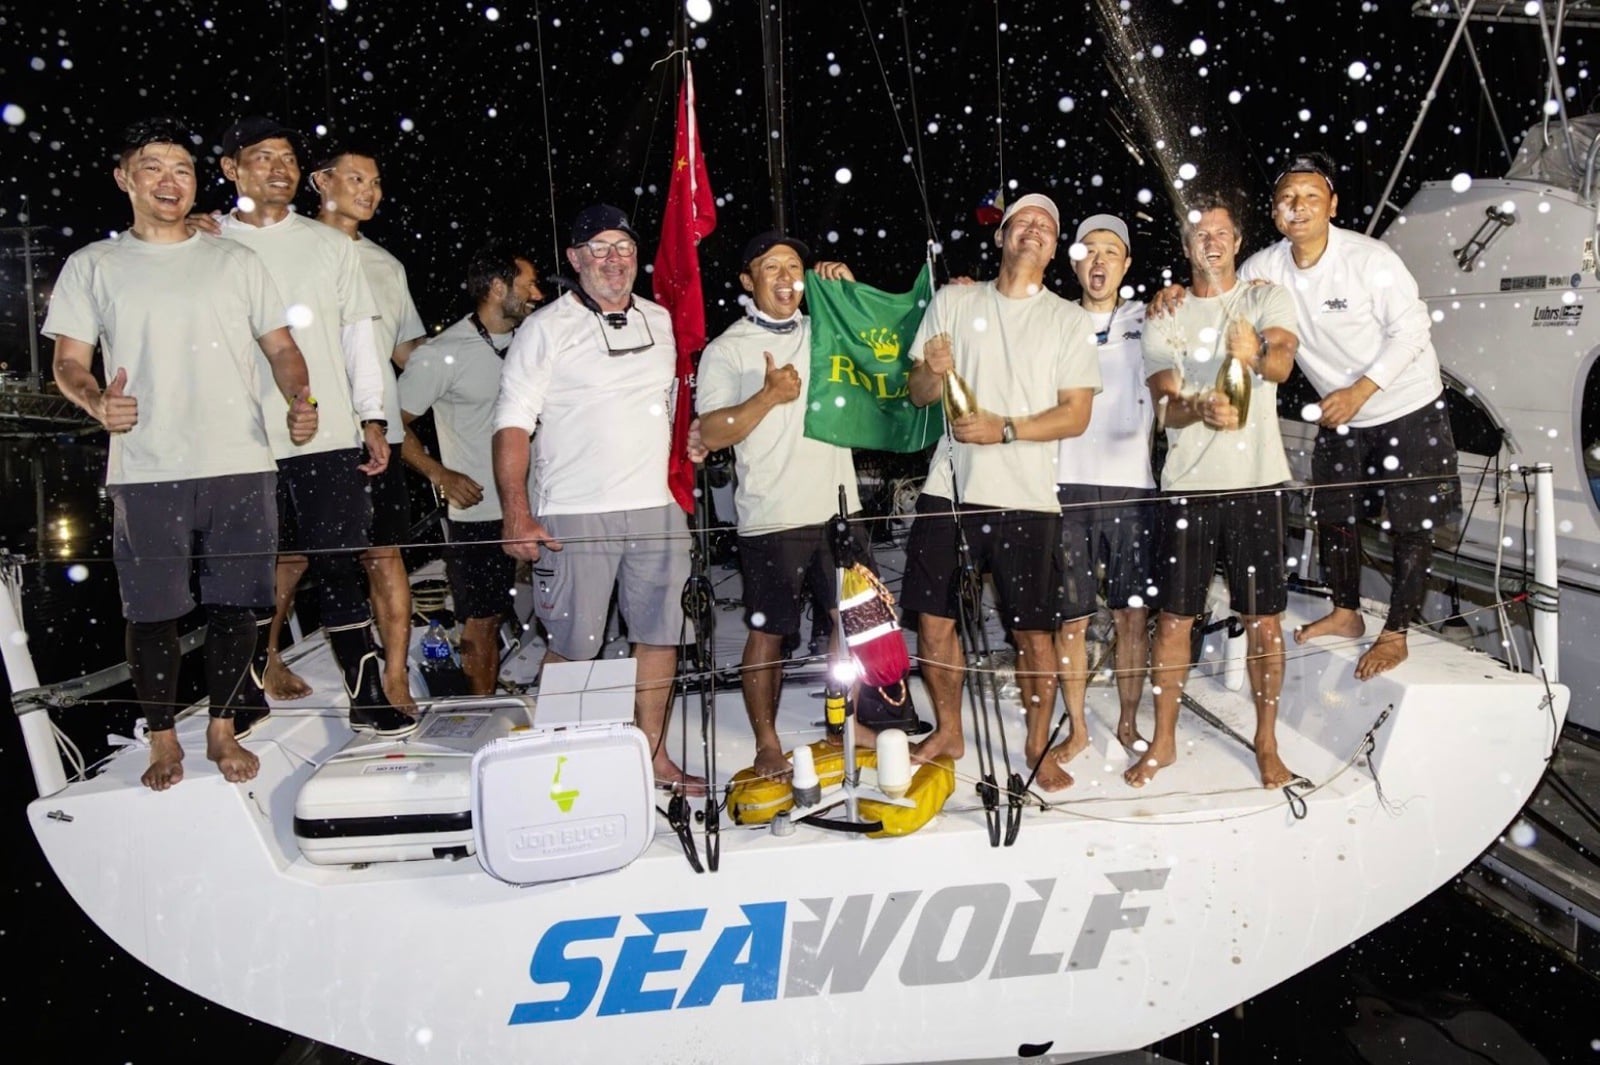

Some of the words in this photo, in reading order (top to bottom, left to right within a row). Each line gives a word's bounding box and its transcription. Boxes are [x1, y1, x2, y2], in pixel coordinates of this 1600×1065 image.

[1534, 305, 1560, 321] Luhrs
[827, 355, 909, 399] ROL
[508, 867, 1172, 1026] SEAWOLF
